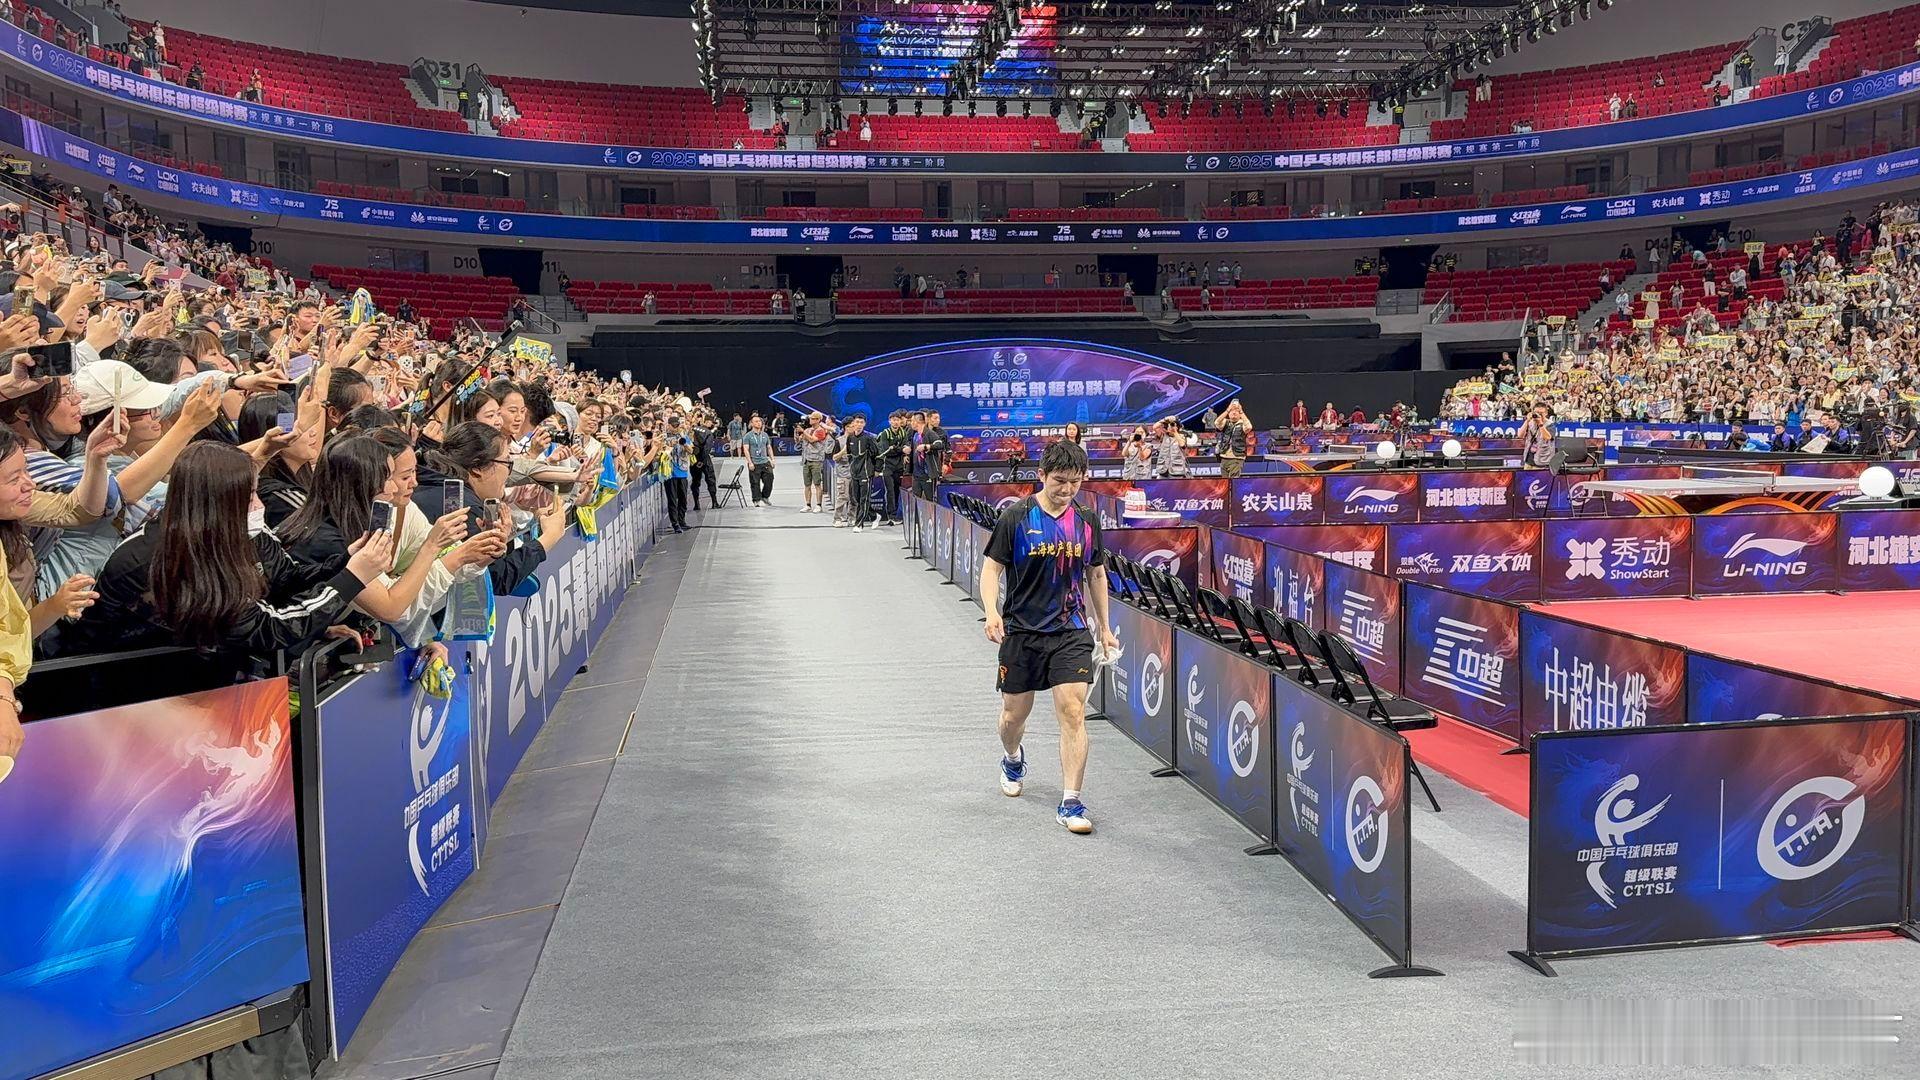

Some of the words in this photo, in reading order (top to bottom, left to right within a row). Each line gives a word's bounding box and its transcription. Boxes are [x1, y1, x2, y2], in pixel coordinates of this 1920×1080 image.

[49, 50, 84, 80] 2025
[1853, 73, 1896, 100] 2025
[651, 151, 697, 167] 2025
[1229, 155, 1273, 170] 2025
[157, 169, 179, 183] LOKI
[1607, 199, 1636, 209] LOKI
[453, 256, 478, 270] D10
[753, 264, 775, 277] D11
[1075, 264, 1097, 276] D12
[987, 368, 1031, 382] 2025
[897, 379, 1122, 400] 中国乒乓球俱乐部超级联赛
[1173, 497, 1224, 511] 双鱼文体
[1242, 491, 1314, 512] 农夫山泉
[1426, 486, 1508, 508] 河北雄安新区
[1344, 503, 1399, 515] LI-NING
[1028, 541, 1082, 558] 上海地产集团
[1610, 536, 1671, 568] 秀动
[1224, 553, 1255, 586] 红双喜
[1396, 565, 1421, 575] Double
[1429, 566, 1444, 575] FISH
[1450, 554, 1533, 574] 双鱼文体
[1723, 561, 1807, 578] LI-NING
[1610, 568, 1670, 581] ShowStart
[1356, 615, 1385, 650] 中超
[1456, 648, 1505, 689] 中超
[1545, 646, 1651, 731] 中超电缆
[404, 764, 460, 830] 中国乒乓球俱乐部
[431, 803, 460, 849] 超级联赛
[1776, 810, 1841, 858] T.T.A.
[431, 831, 460, 873] CTTSL
[1576, 841, 1679, 864] 中国乒乓球俱乐部
[1624, 866, 1678, 884] 超级联赛
[1623, 883, 1675, 898] CTTSL
